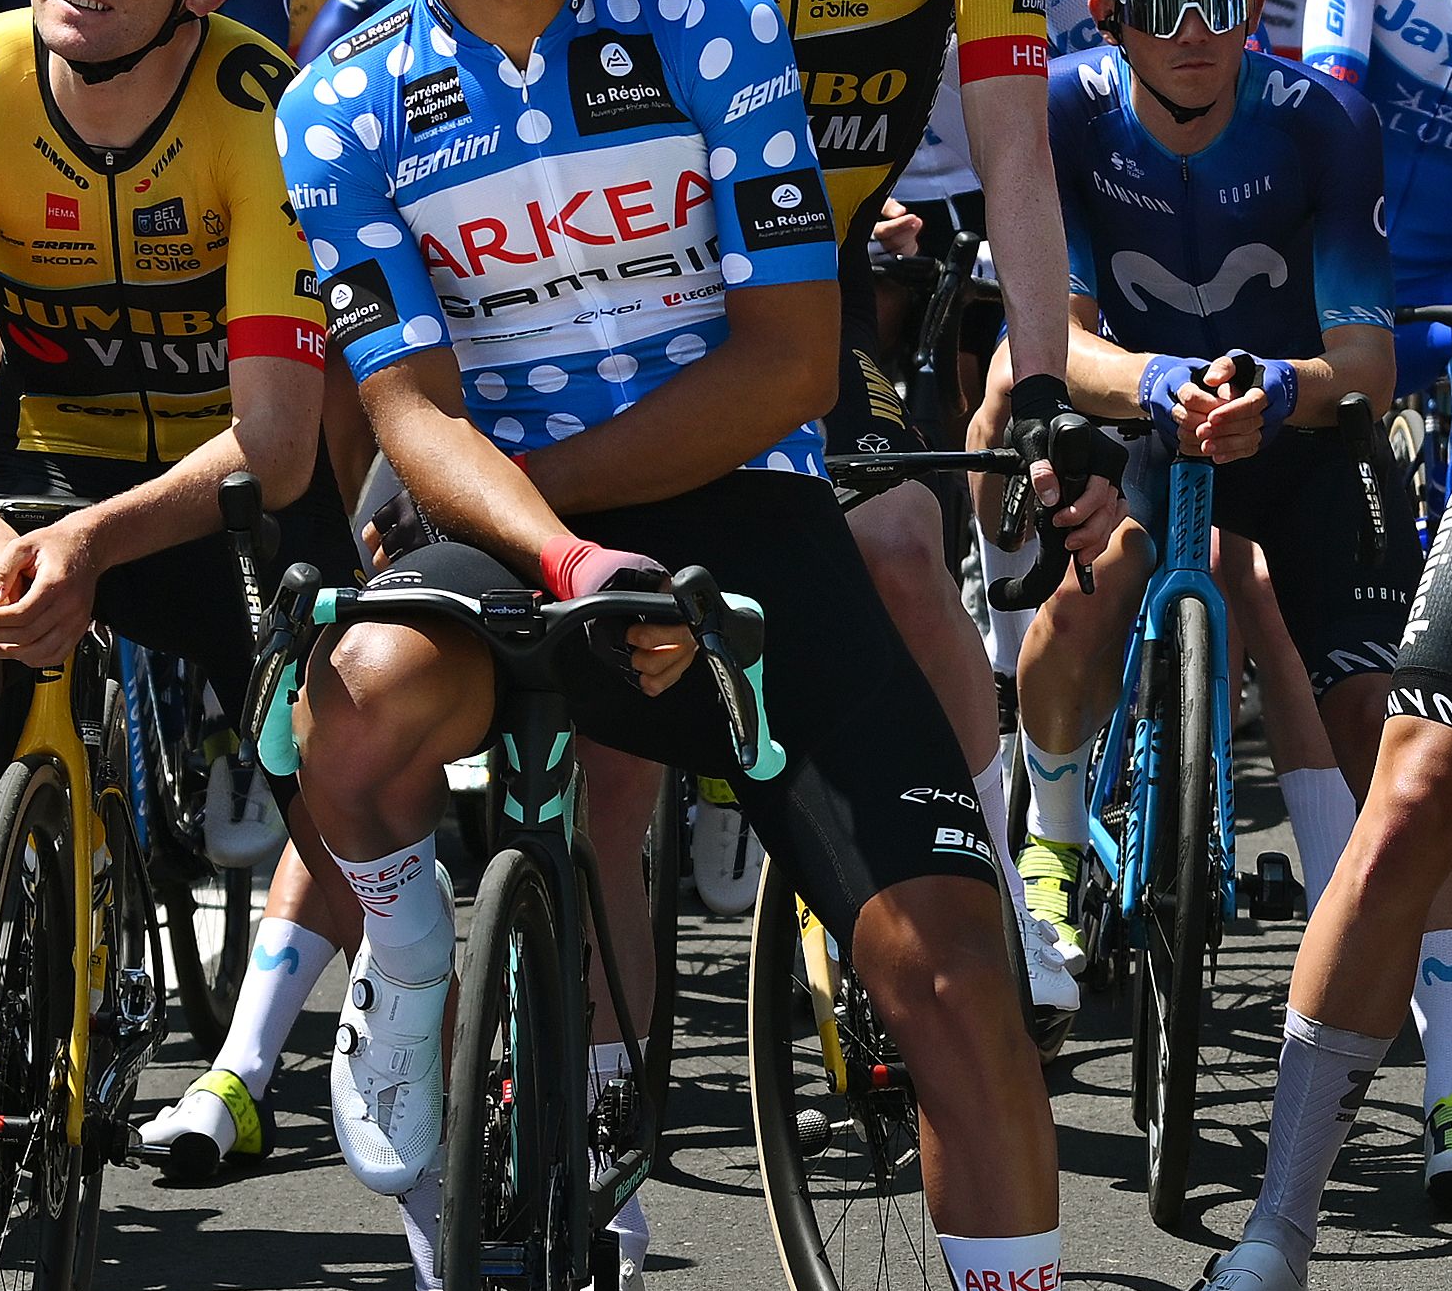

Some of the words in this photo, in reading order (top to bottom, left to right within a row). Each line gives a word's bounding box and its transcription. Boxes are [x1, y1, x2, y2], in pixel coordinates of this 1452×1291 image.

[586, 90, 604, 106] La
[32, 135, 90, 190] JUMBO
[151, 137, 184, 180] VISMA
[396, 125, 501, 189] Santini
[1093, 169, 1175, 215] CANYON
[1219, 175, 1272, 206] GOBIK
[48, 207, 76, 219] HEMA
[154, 206, 176, 221] BET
[754, 219, 771, 232] La
[773, 210, 828, 231] Région
[155, 218, 182, 232] CITY
[32, 241, 96, 250] SRAM
[134, 241, 193, 256] lease
[1354, 587, 1407, 605] GOBIK
[486, 607, 527, 617] wahoo
